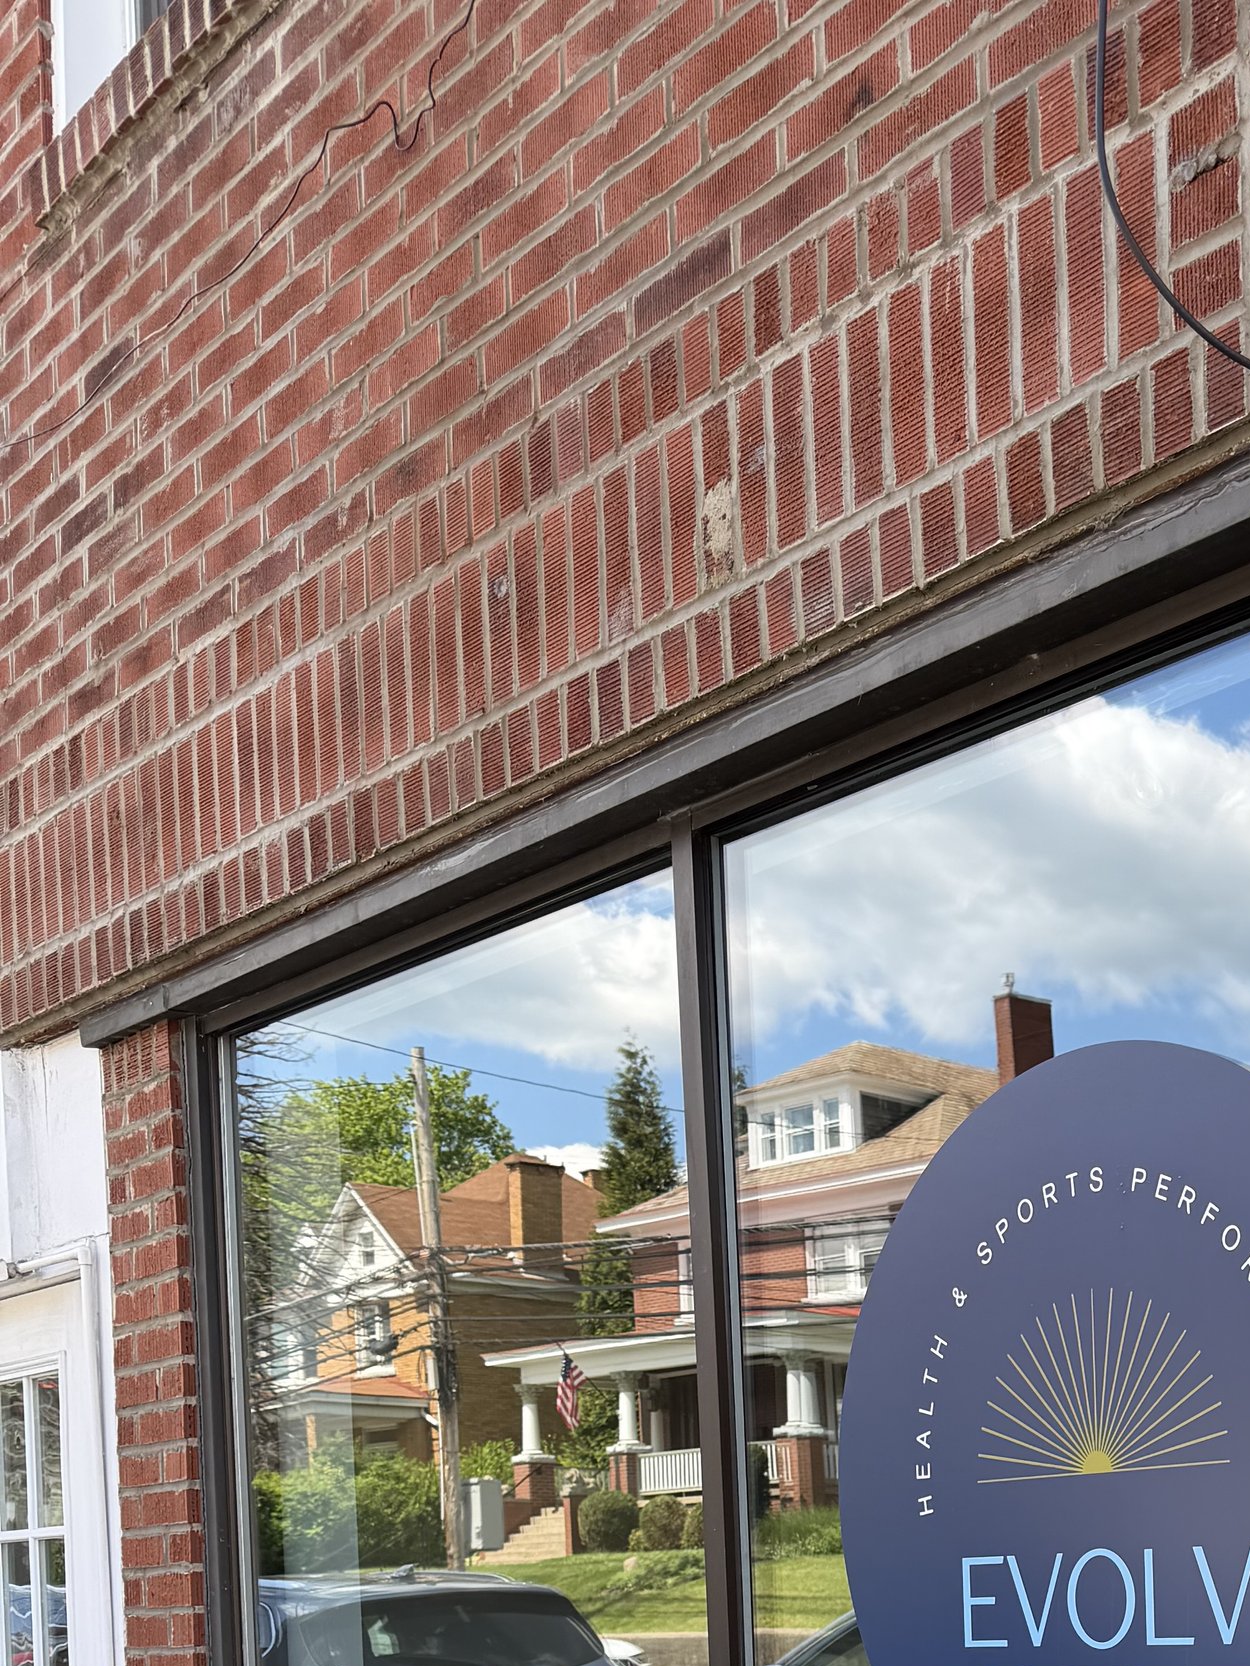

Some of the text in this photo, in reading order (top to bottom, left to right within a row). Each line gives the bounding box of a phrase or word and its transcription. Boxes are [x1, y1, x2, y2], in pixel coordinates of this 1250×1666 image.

[914, 1333, 949, 1517] HEALTH
[951, 1286, 969, 1309] &
[975, 1165, 1105, 1266] SPORTS
